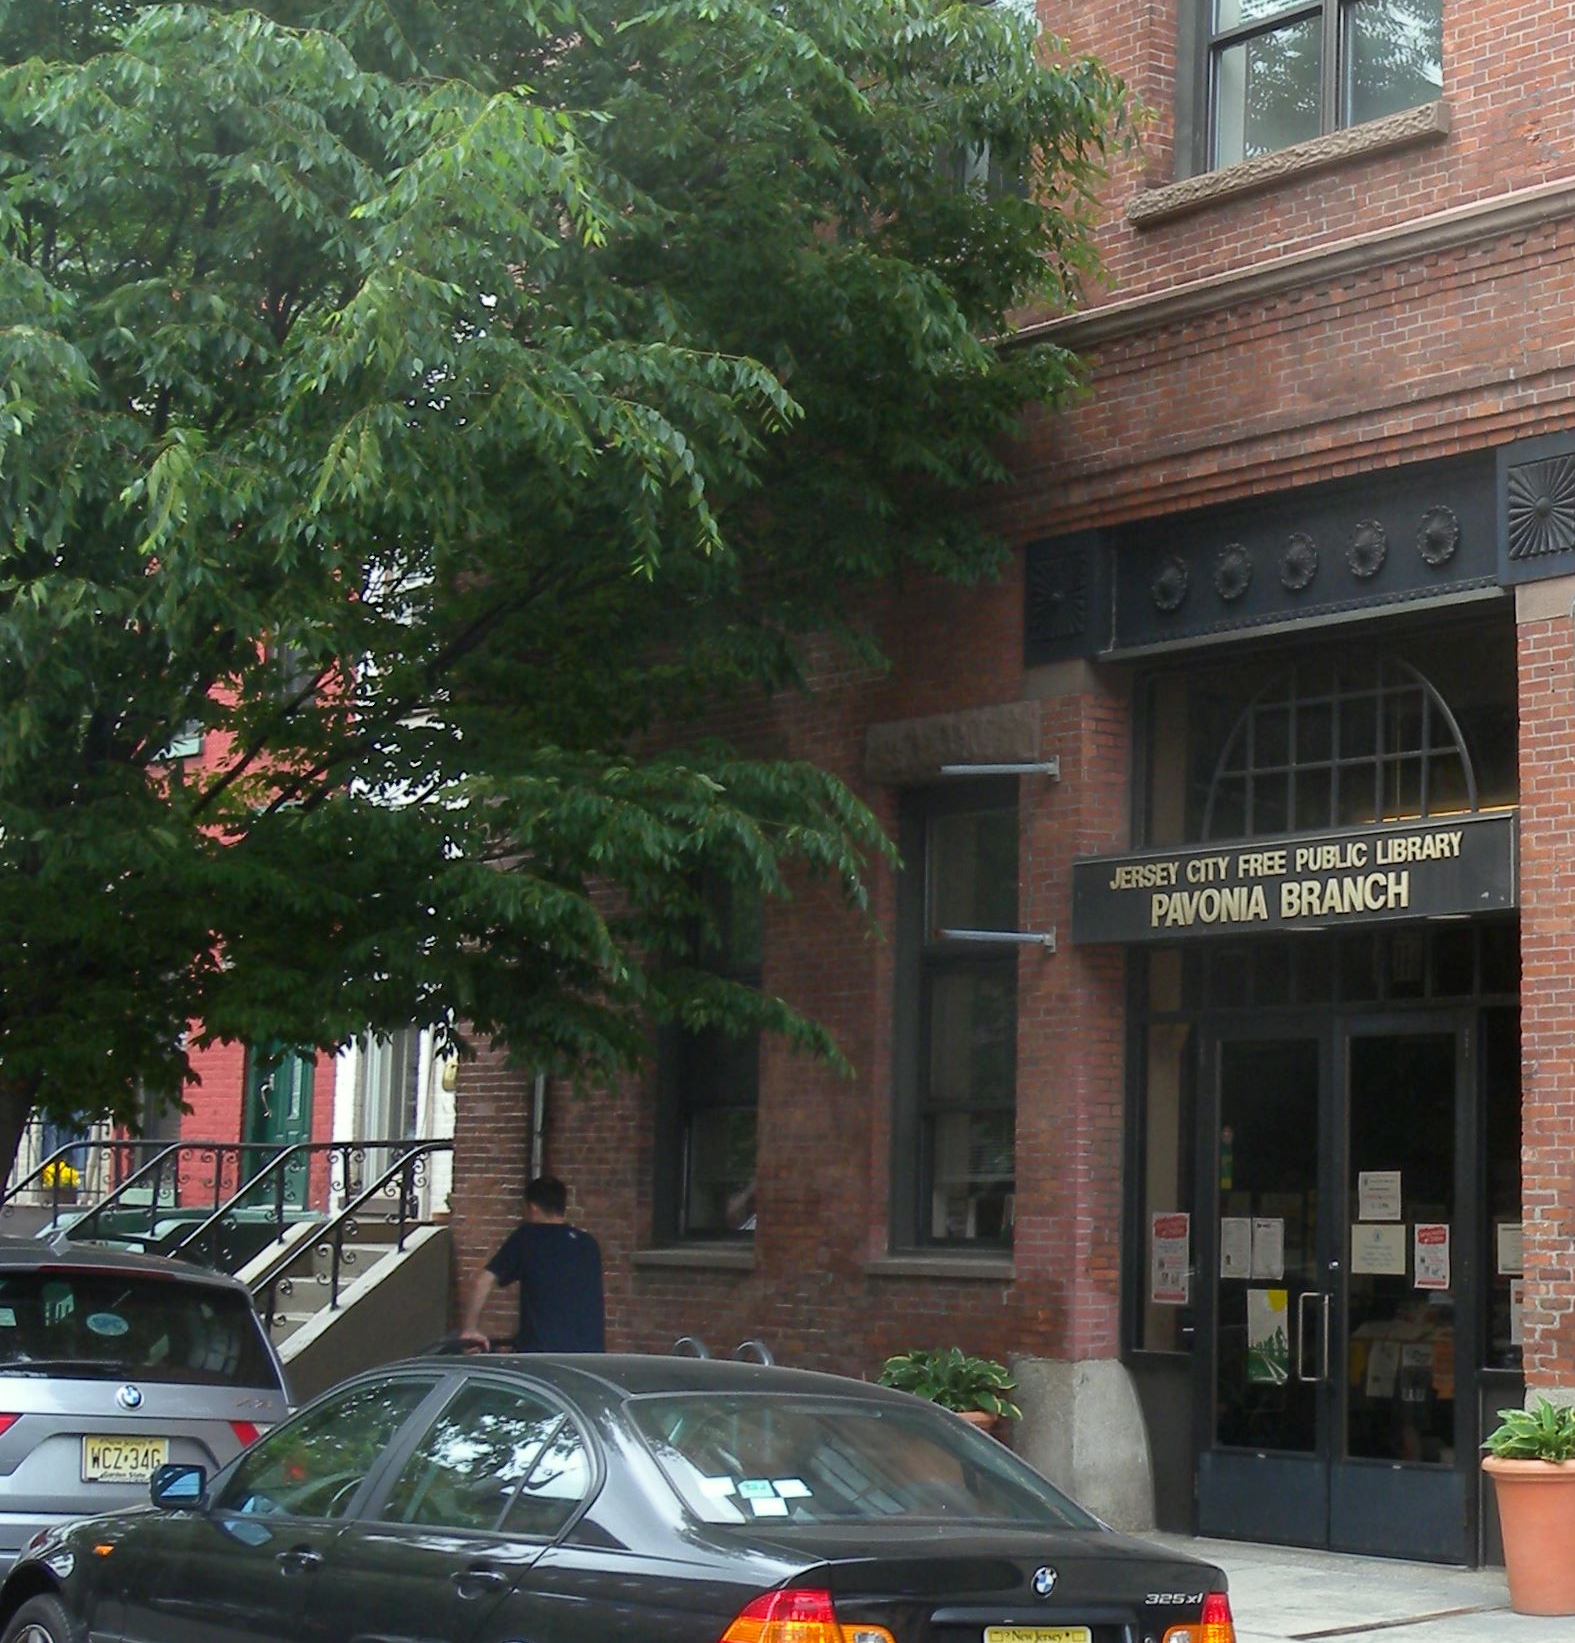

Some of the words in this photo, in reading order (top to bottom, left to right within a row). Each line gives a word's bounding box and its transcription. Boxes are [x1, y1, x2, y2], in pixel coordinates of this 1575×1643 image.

[1109, 861, 1180, 890] JERSEY
[1186, 856, 1230, 884] CITY
[1238, 850, 1287, 878] FREE
[1296, 842, 1368, 872] PUBLIC
[1376, 830, 1463, 865] LIBRARY
[1151, 884, 1269, 928] PAVONIA
[1280, 870, 1410, 919] BRANCH
